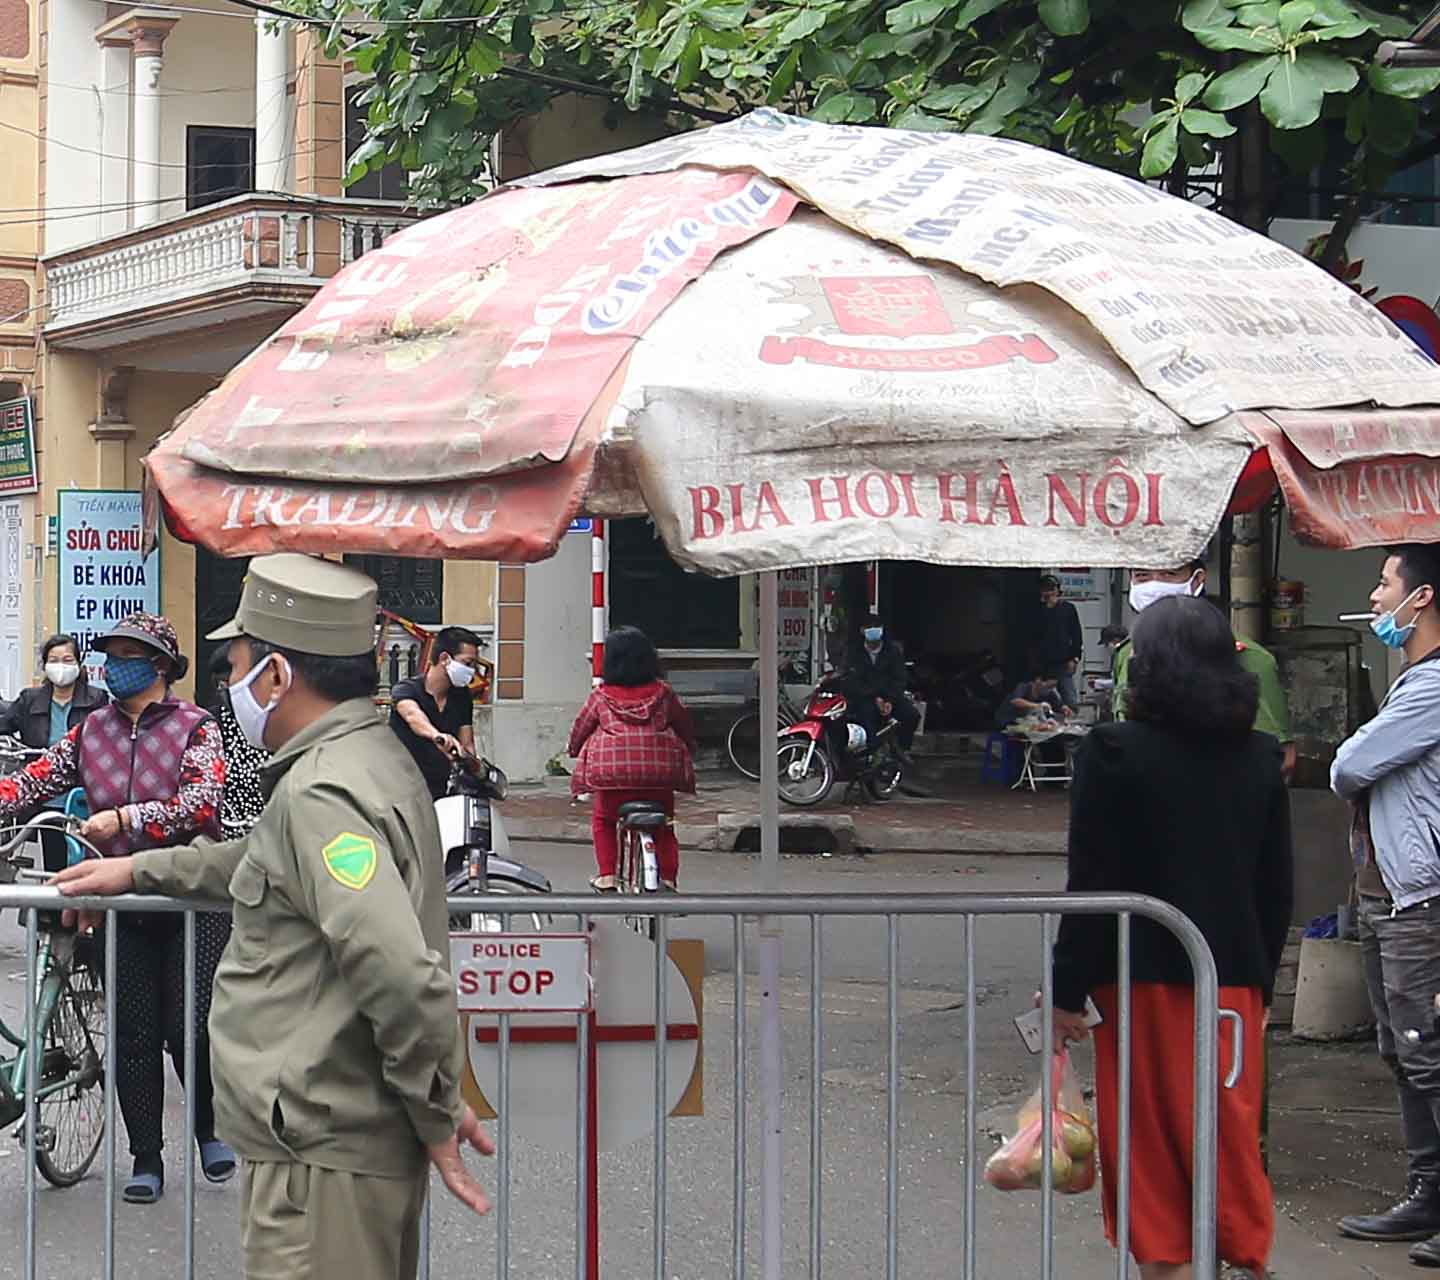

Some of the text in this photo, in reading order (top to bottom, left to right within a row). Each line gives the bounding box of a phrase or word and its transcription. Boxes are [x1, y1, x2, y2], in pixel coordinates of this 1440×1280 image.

[220, 481, 500, 535] TRADING
[688, 476, 799, 542] BIA
[936, 458, 1028, 527] HÀ
[1045, 459, 1166, 533] NỘI
[66, 520, 101, 551] SỬA
[100, 559, 146, 586] KHÓA
[76, 595, 97, 620] ÉP
[472, 942, 542, 960] POLICE
[458, 968, 556, 997] STOP
